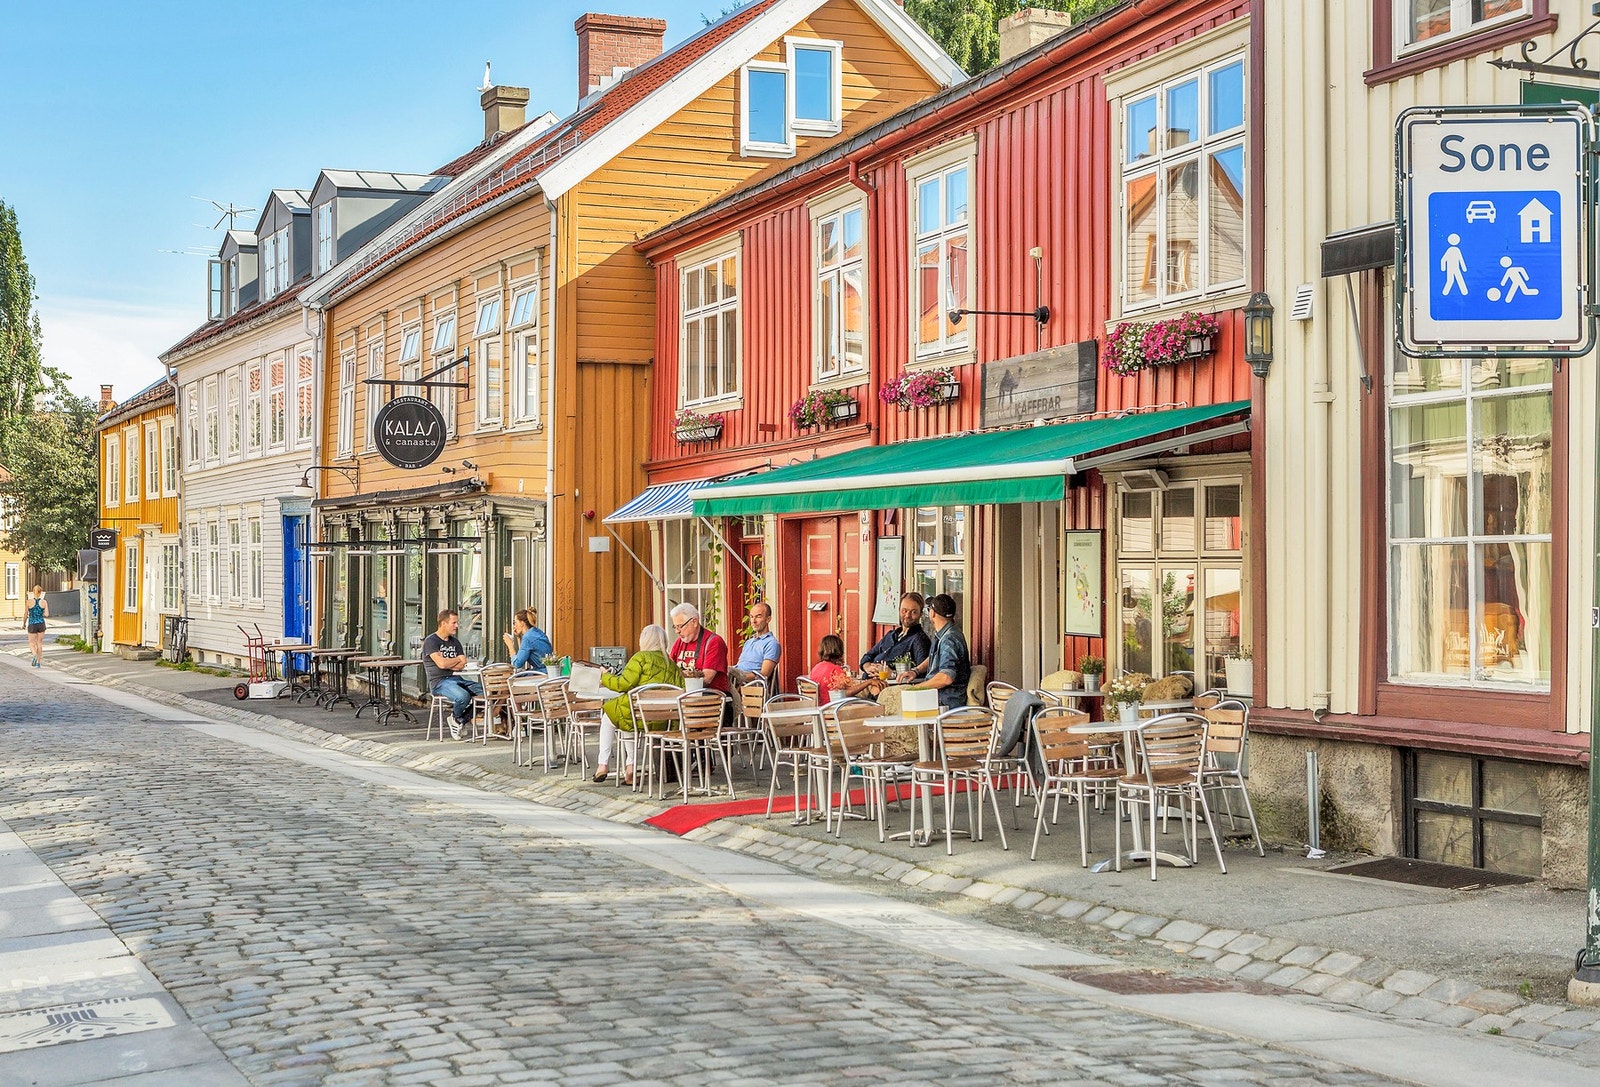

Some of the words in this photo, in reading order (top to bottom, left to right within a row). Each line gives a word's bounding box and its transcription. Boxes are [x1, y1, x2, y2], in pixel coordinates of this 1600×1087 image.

[1438, 134, 1550, 173] Sone
[393, 397, 428, 406] RESTAURANT
[1014, 396, 1061, 416] KAFFEBAR
[385, 420, 436, 436] KALAS
